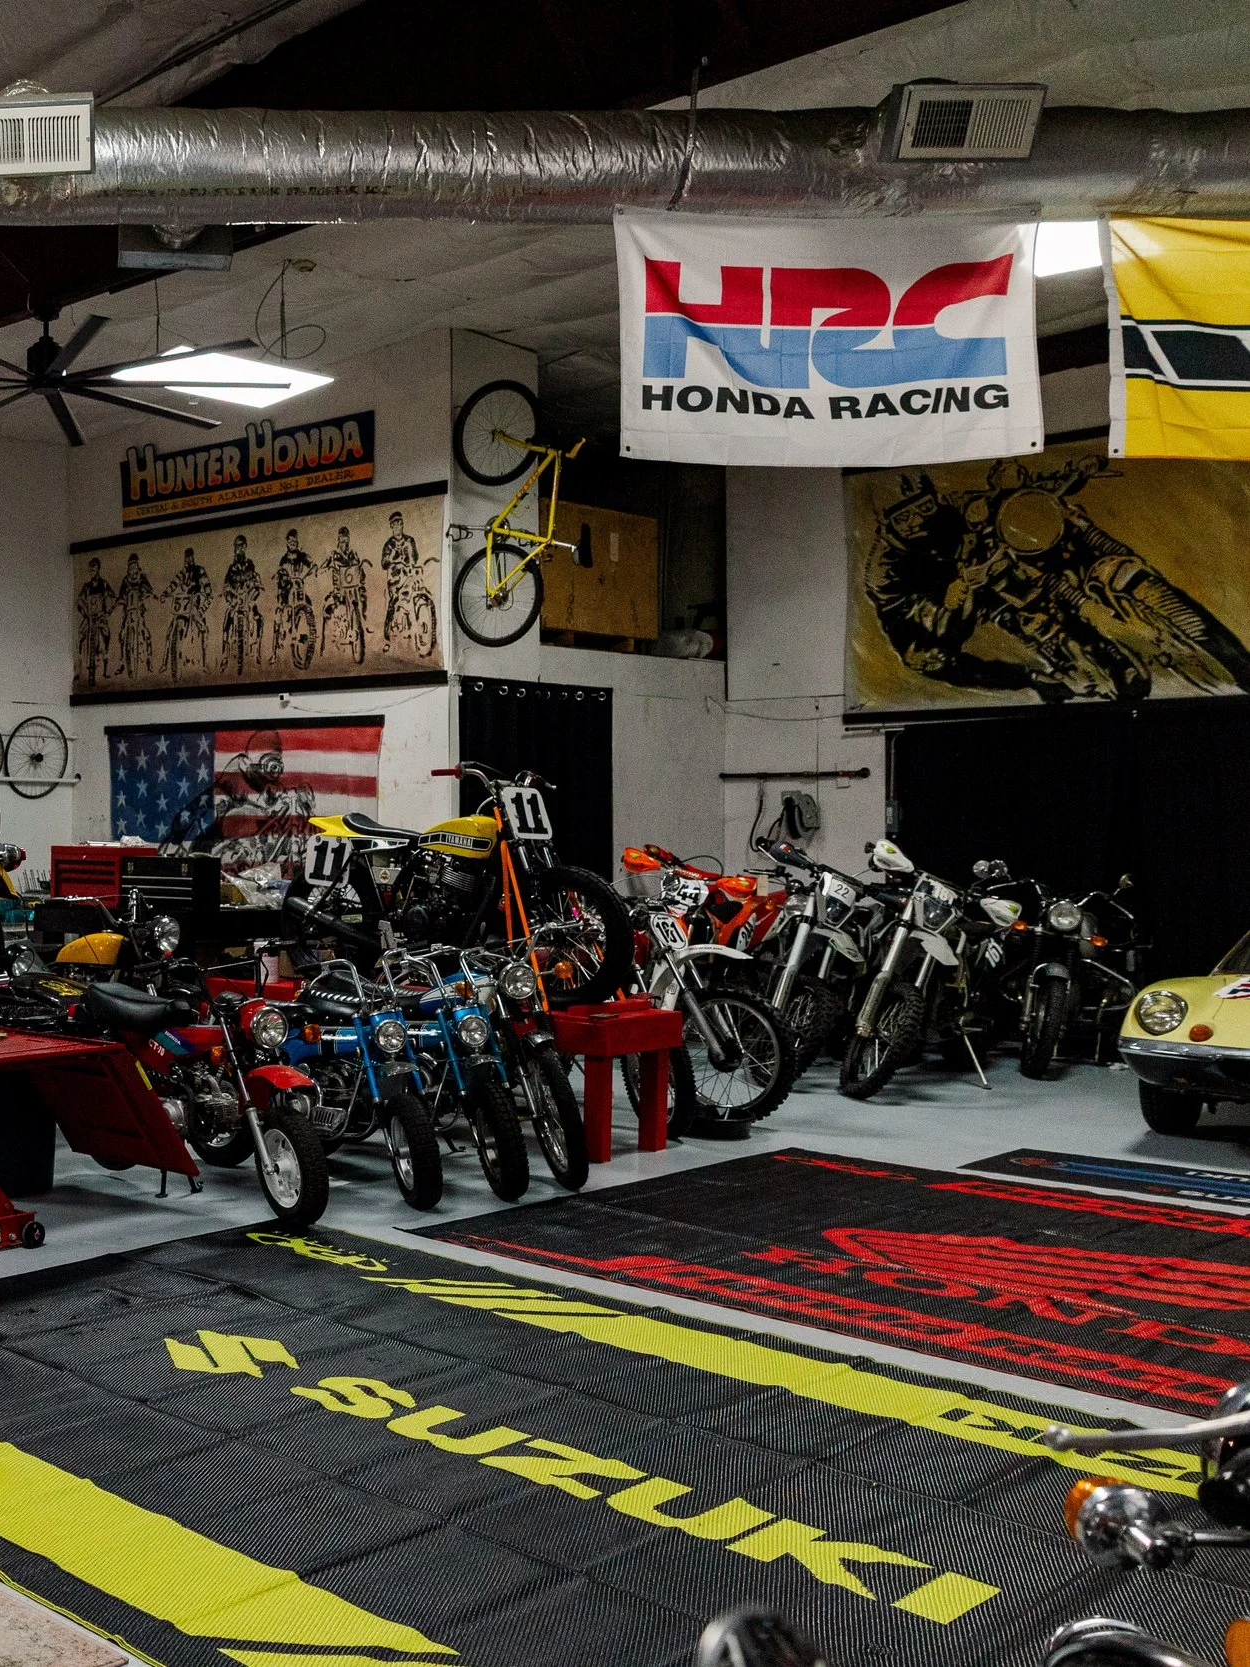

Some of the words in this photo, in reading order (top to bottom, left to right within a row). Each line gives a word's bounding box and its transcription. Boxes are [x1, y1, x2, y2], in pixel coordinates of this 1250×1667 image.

[643, 253, 1014, 389] HRC
[641, 384, 816, 420] HONDA
[828, 383, 1010, 420] RACING
[127, 443, 243, 501] HUNTER
[245, 418, 363, 480] HONDA
[181, 495, 214, 509] SOUTH
[219, 484, 273, 503] ALABAMAS
[306, 470, 353, 486] DEALER
[508, 791, 550, 836] 11
[310, 839, 351, 883] 11
[447, 834, 472, 847] YAMAHA
[833, 883, 851, 899] 22
[655, 921, 685, 944] 161
[164, 1030, 181, 1046] HONDA
[740, 1244, 1250, 1362] HOND
[291, 1375, 1002, 1625] SUZUKI
